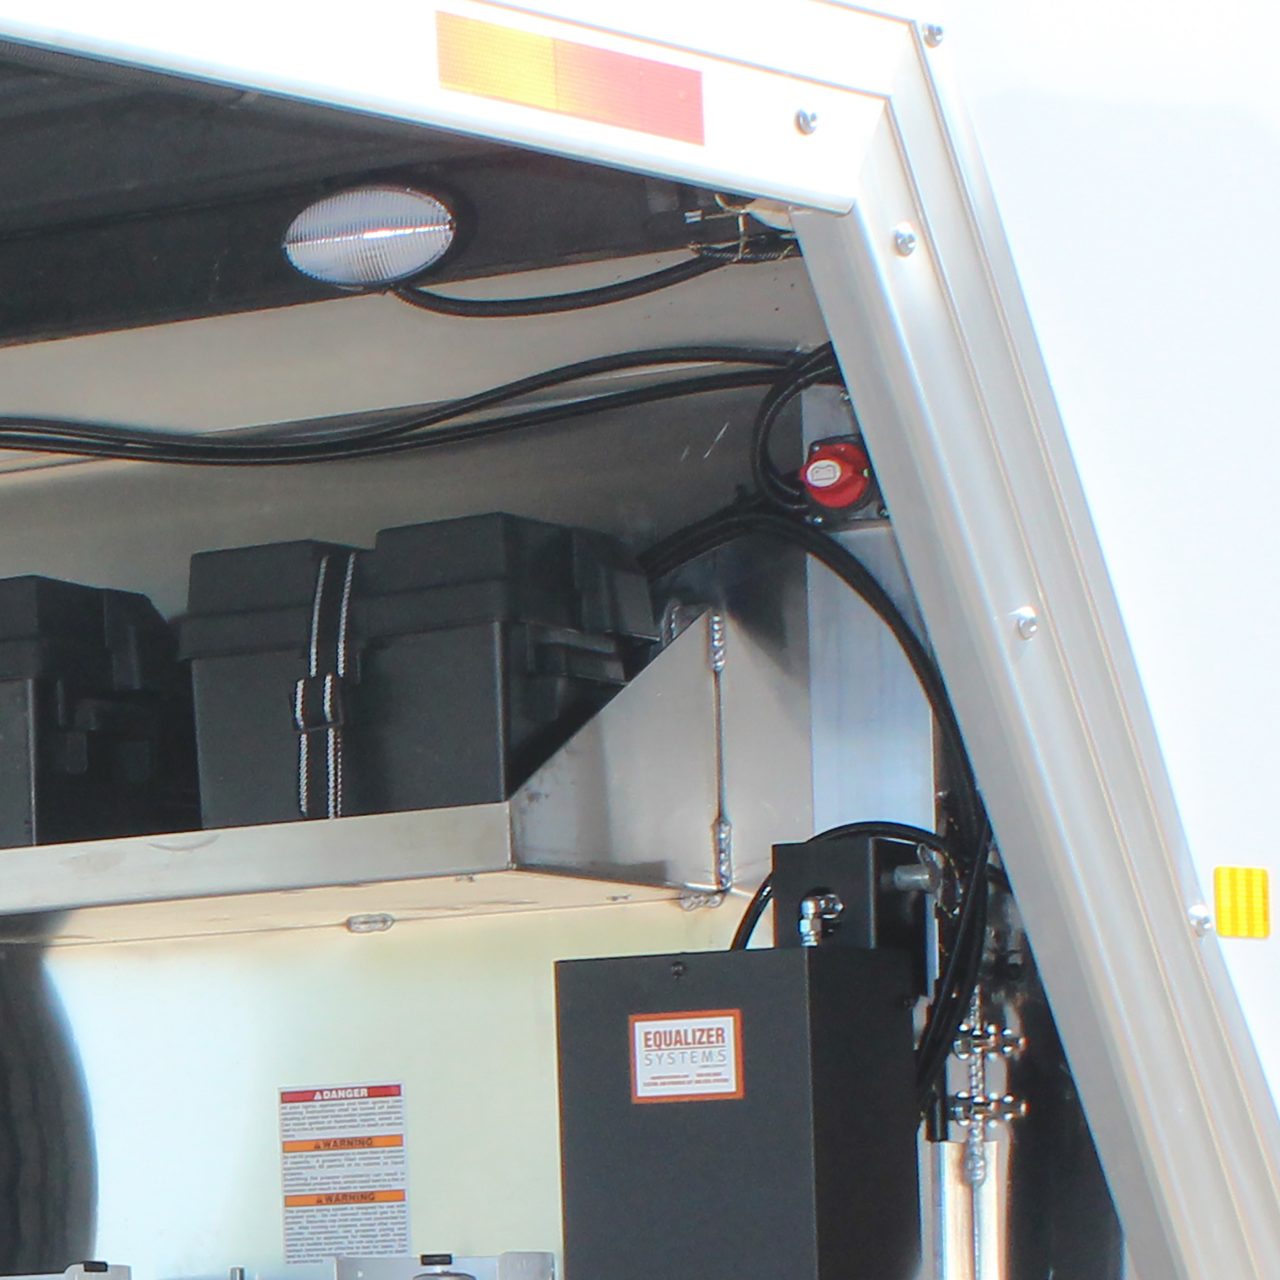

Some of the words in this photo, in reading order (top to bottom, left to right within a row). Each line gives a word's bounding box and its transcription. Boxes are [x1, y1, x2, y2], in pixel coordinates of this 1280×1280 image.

[643, 1027, 725, 1050] EQUALIZER
[644, 1049, 726, 1066] SYSTEMS
[323, 1088, 369, 1100] DANGER
[324, 1138, 373, 1149] WARNING
[326, 1192, 376, 1203] WARNING
